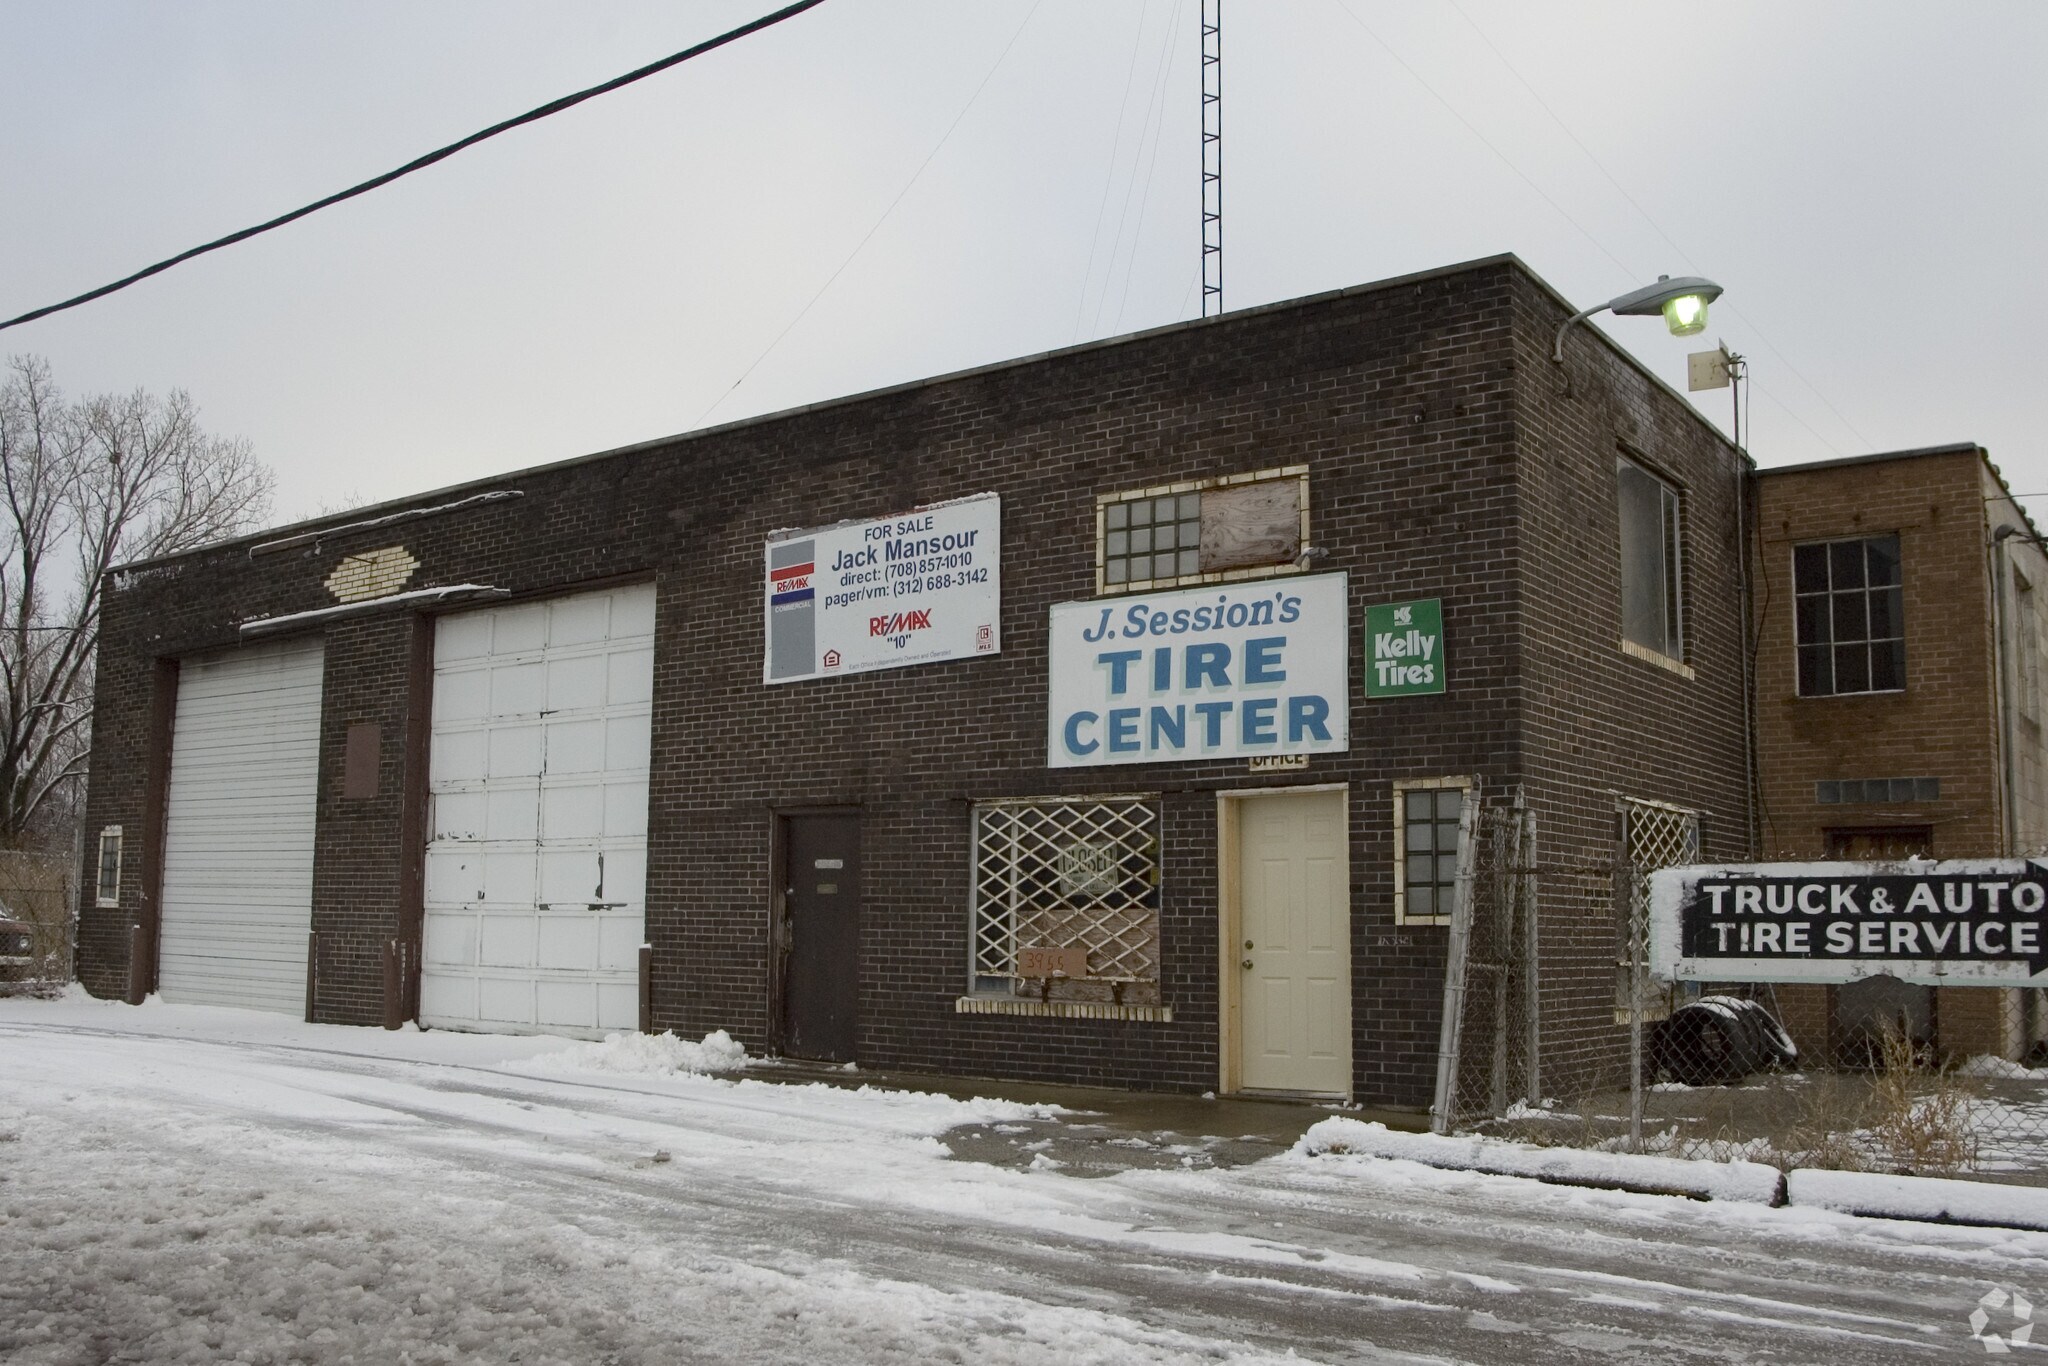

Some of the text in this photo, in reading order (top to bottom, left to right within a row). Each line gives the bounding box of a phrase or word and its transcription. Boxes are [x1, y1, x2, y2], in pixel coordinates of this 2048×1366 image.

[865, 516, 934, 542] FOR SALE
[831, 529, 979, 571] Jack Mansour
[777, 577, 809, 593] RE/MAX
[840, 551, 972, 587] direct: (708) 857-1010
[825, 568, 988, 610] pager/vm: (312) 688-3142
[775, 600, 811, 613] COMMERCIAL
[869, 608, 932, 637] RE/MAX
[1082, 591, 1302, 643] J. Session's
[887, 634, 912, 649] "10"
[1375, 629, 1435, 661] Kelly
[874, 656, 903, 667] Idependently
[1096, 636, 1287, 696] TIRE
[1374, 660, 1434, 687] Tires
[1063, 695, 1332, 757] CENTER
[1253, 755, 1303, 767] OFFICE
[1703, 880, 2047, 915] TRUCK & AUTO
[1709, 921, 2040, 954] TIRE SERVICE
